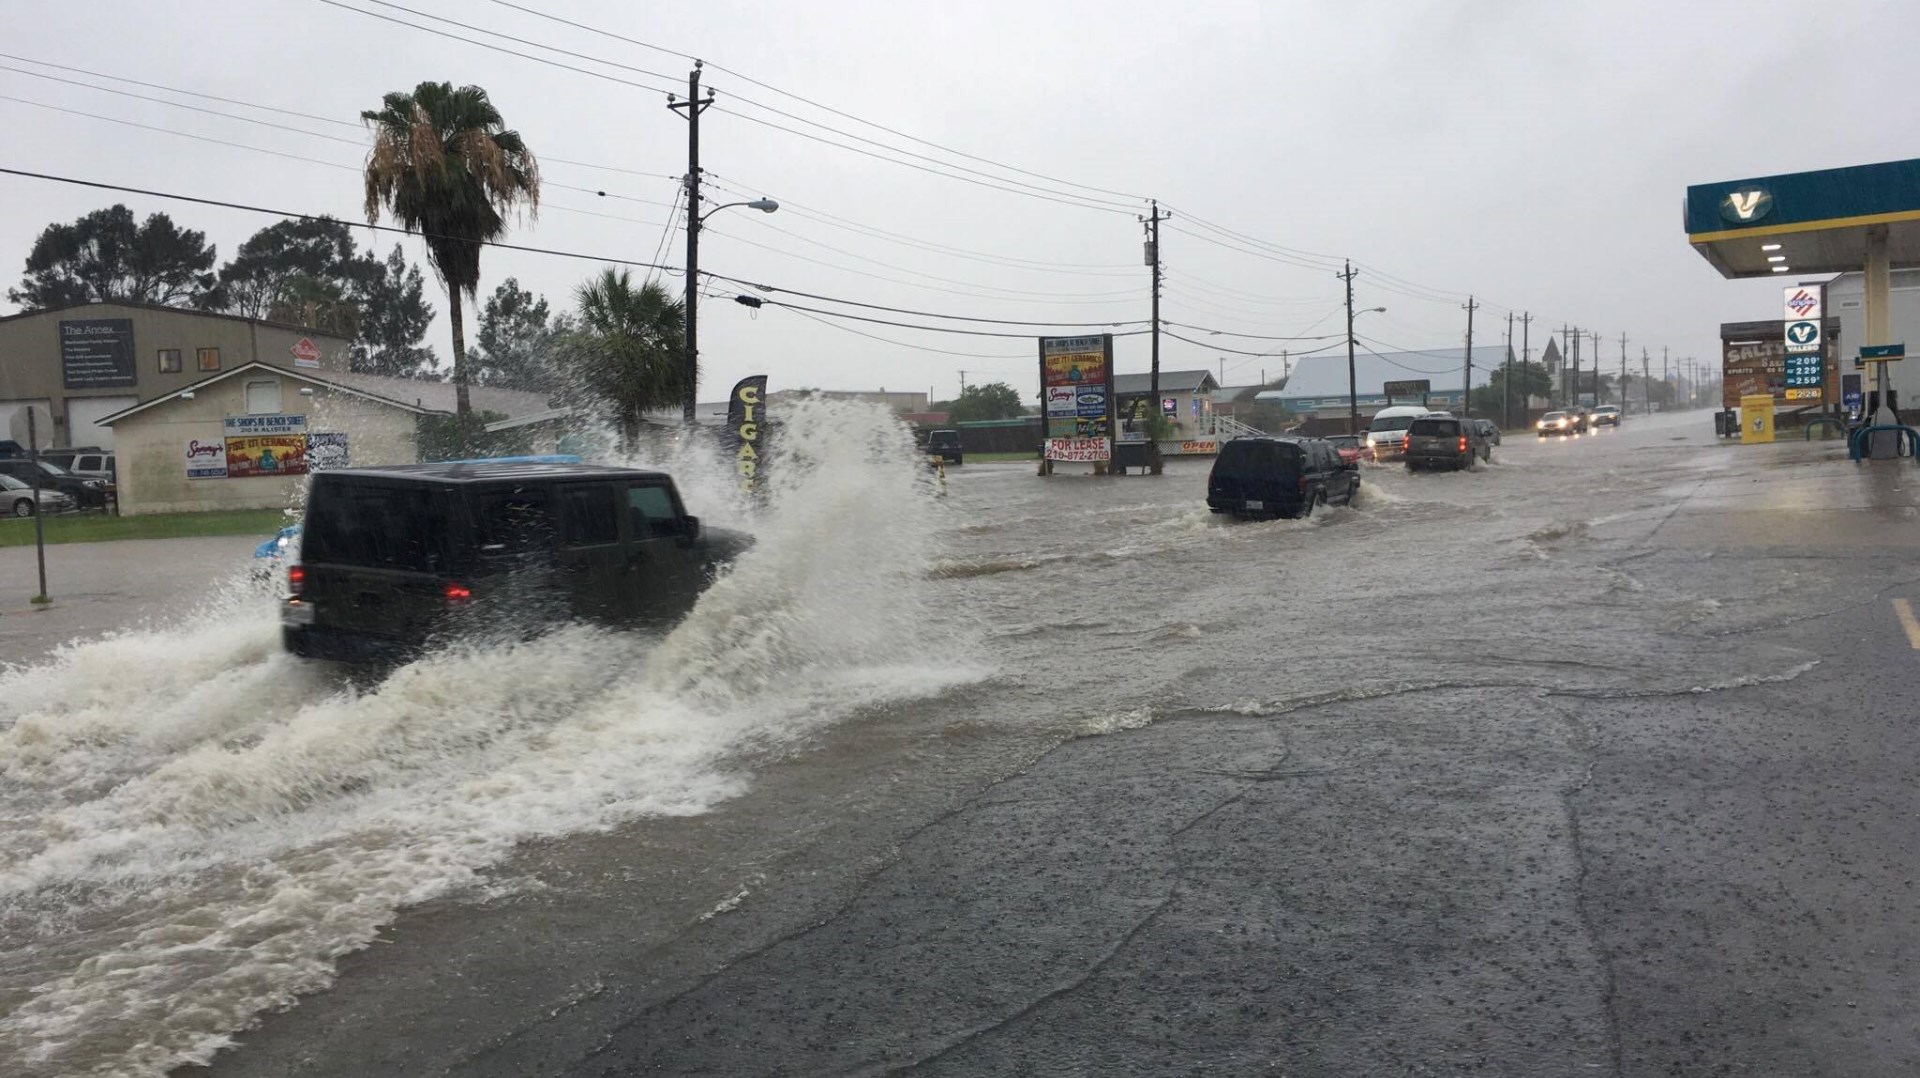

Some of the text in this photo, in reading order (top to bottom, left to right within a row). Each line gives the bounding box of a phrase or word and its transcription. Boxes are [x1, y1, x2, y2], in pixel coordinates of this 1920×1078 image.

[64, 325, 113, 336] The Annex
[1786, 345, 1820, 353] VALERO
[225, 416, 304, 427] THE SHOPS AT BEACH STREET
[228, 441, 245, 452] FIRE
[1052, 438, 1104, 451] FOR LEASE
[1183, 441, 1215, 450] OPEN
[1046, 449, 1110, 460] 210-872-2709
